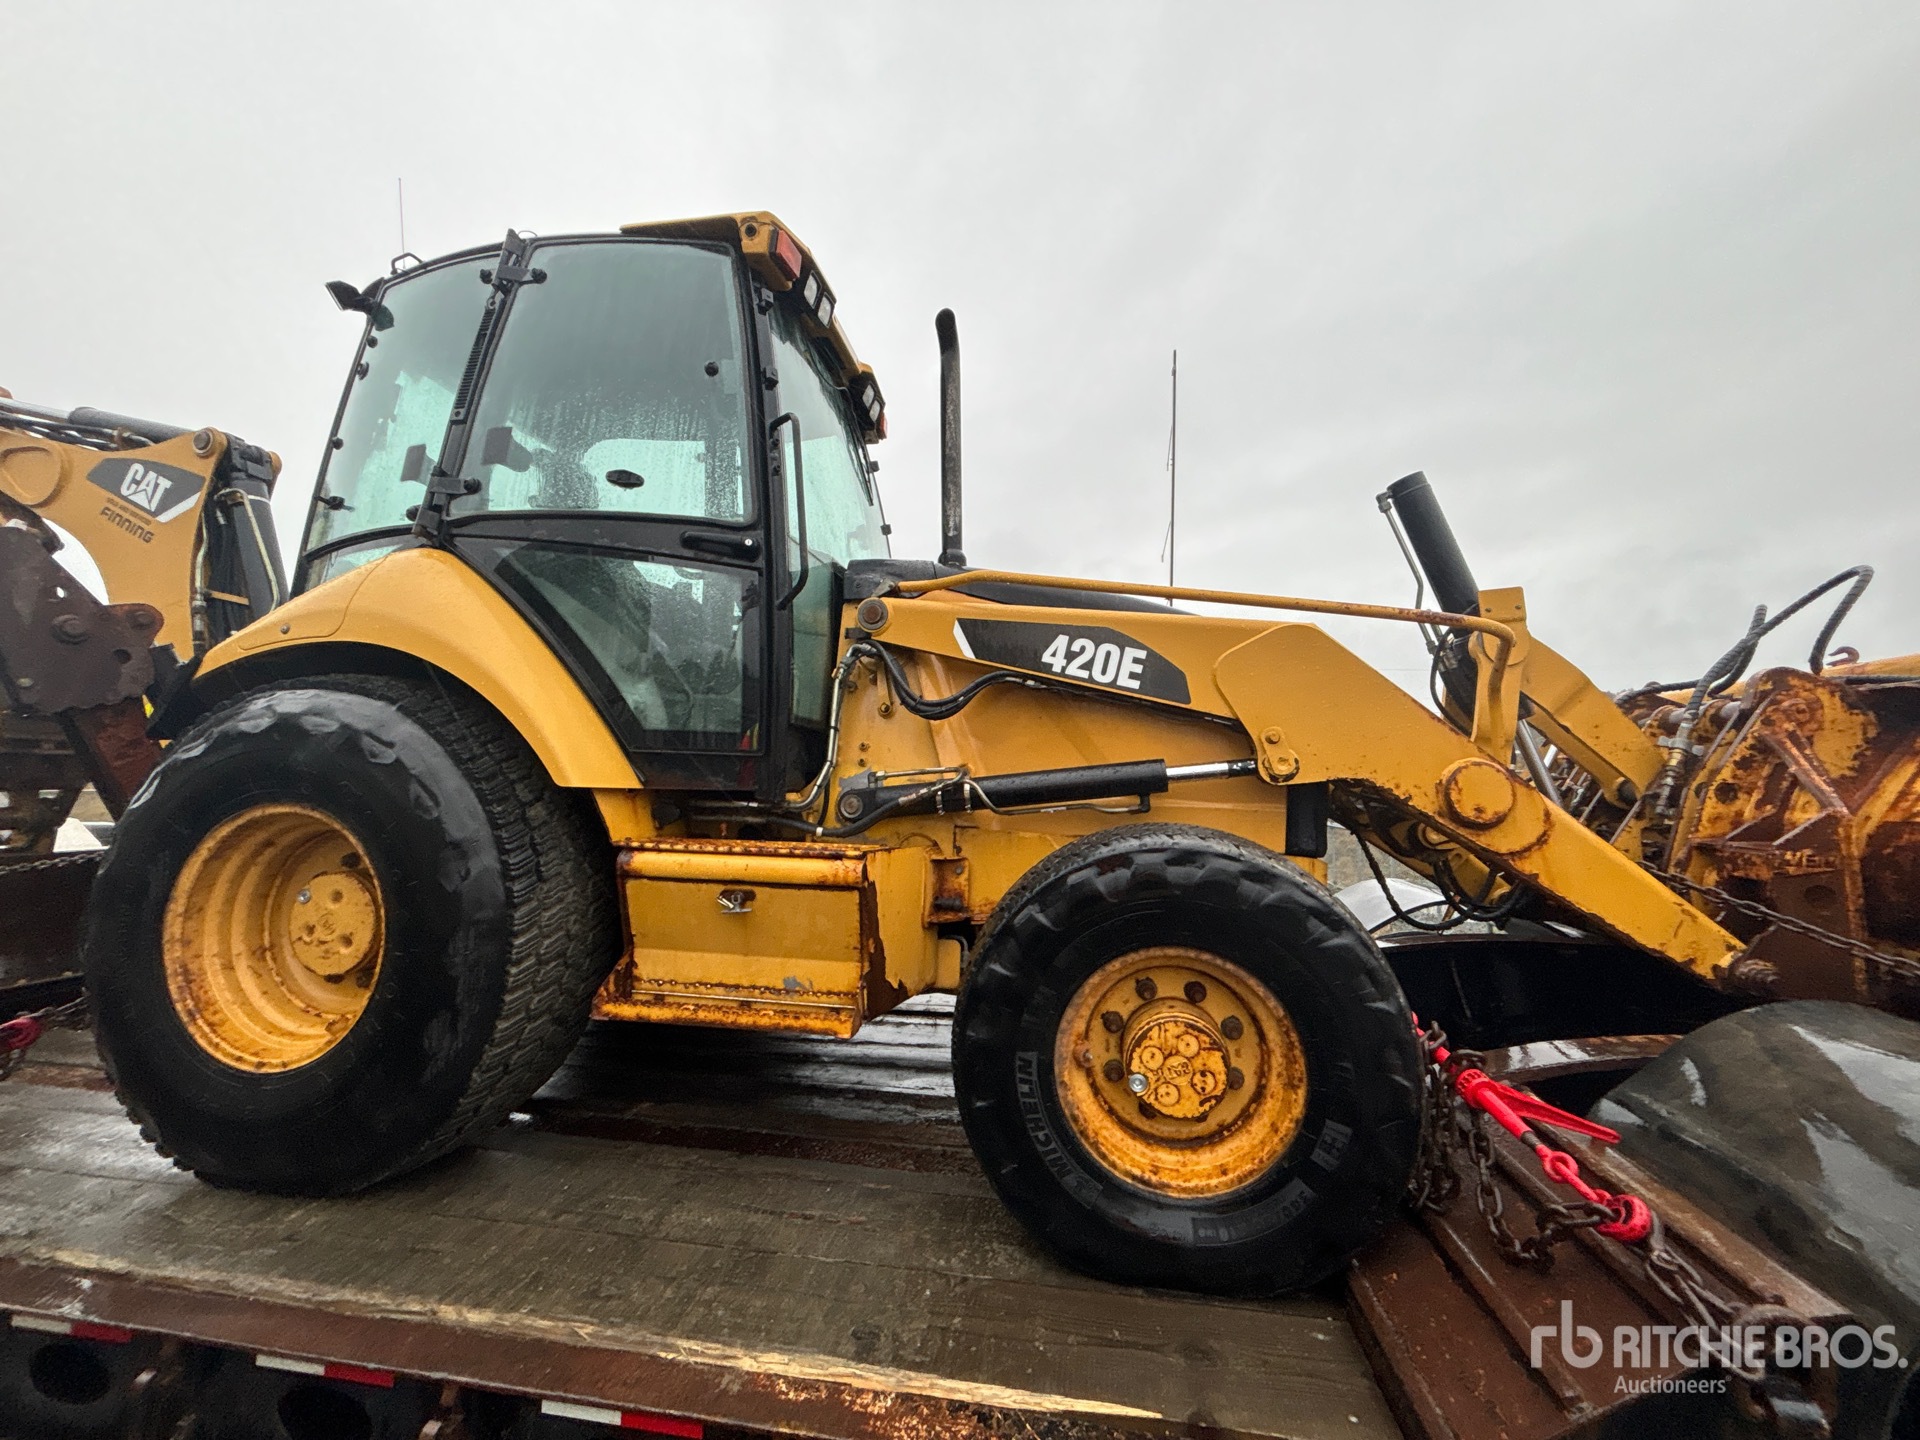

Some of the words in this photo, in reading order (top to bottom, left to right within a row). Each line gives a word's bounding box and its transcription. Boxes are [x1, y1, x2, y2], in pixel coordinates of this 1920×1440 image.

[120, 462, 173, 512] CAT
[100, 506, 155, 544] FINNING
[1041, 634, 1147, 690] 420E
[1017, 1056, 1075, 1180] MICHELIN
